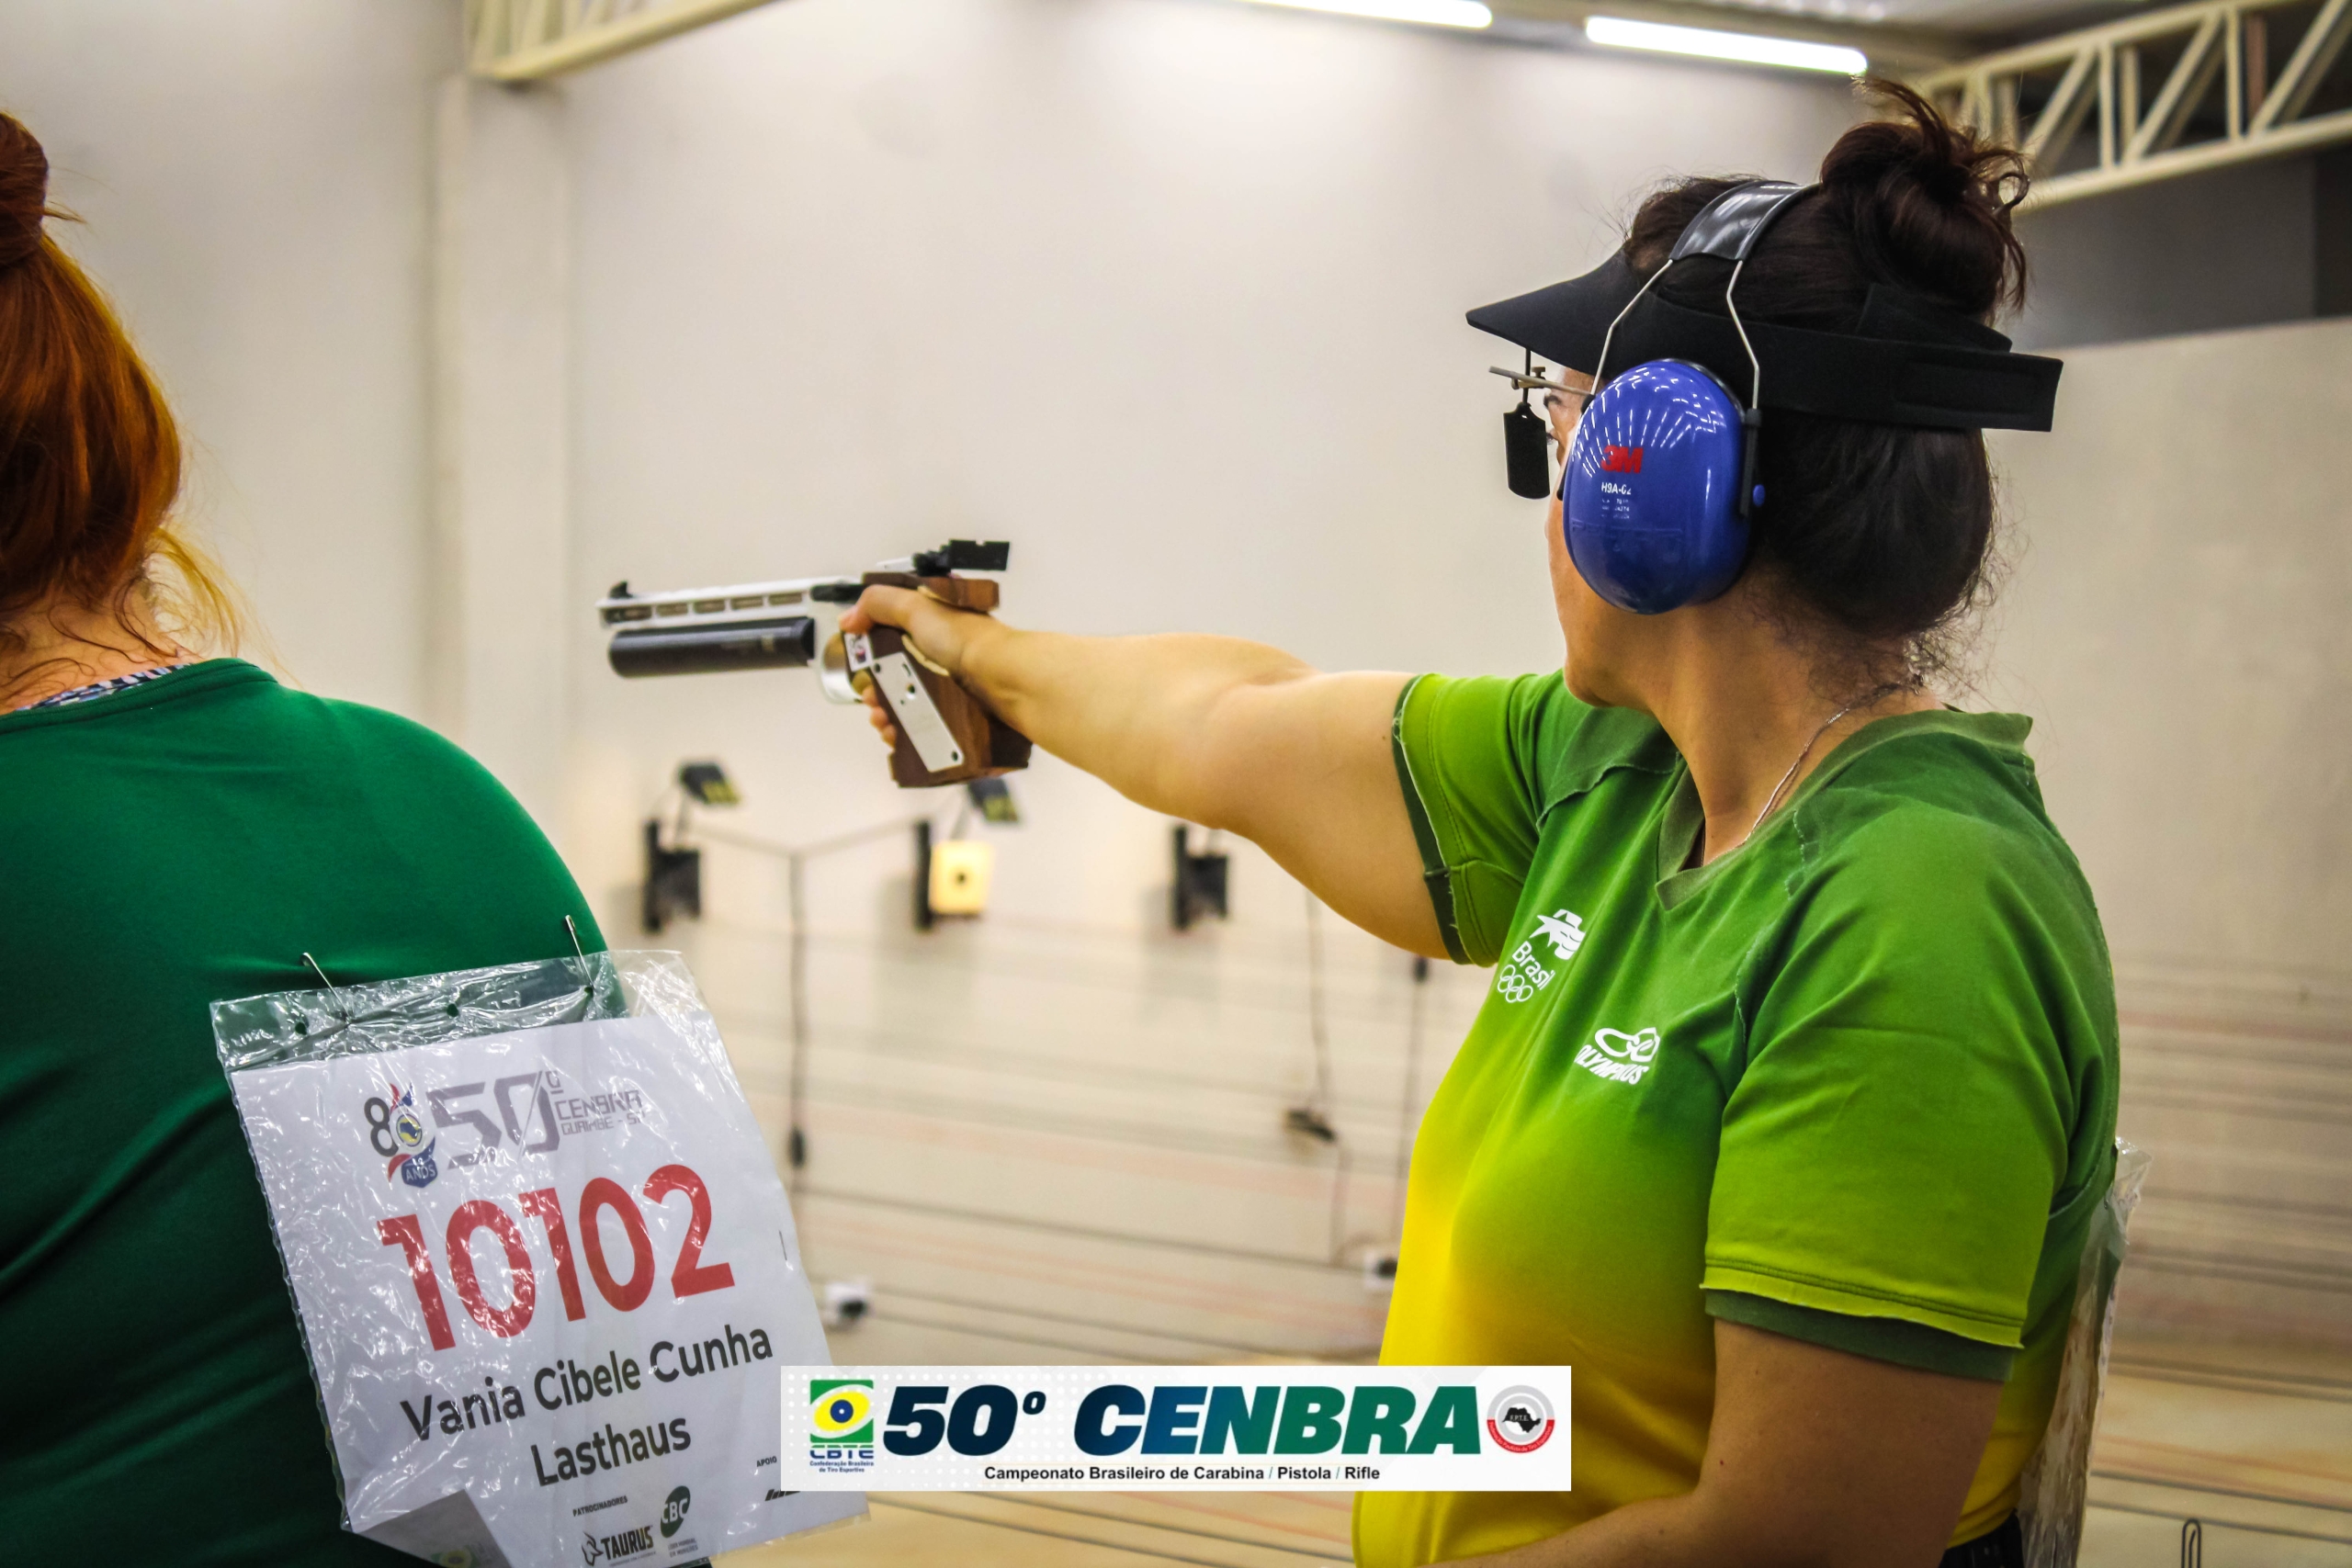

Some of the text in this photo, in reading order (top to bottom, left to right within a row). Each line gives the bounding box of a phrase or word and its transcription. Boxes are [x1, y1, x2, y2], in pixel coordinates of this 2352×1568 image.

[1600, 445, 1644, 474] 3M
[1511, 941, 1555, 991] Brasil
[378, 1165, 735, 1350] 10102
[401, 1324, 774, 1440] Vania Cibele Cunha
[530, 1417, 692, 1486] Lasthaus
[756, 1456, 777, 1467] APOIO
[572, 1495, 628, 1517] PATROCINADORES
[661, 1497, 688, 1525] CBC
[601, 1526, 654, 1561] TAURUS
